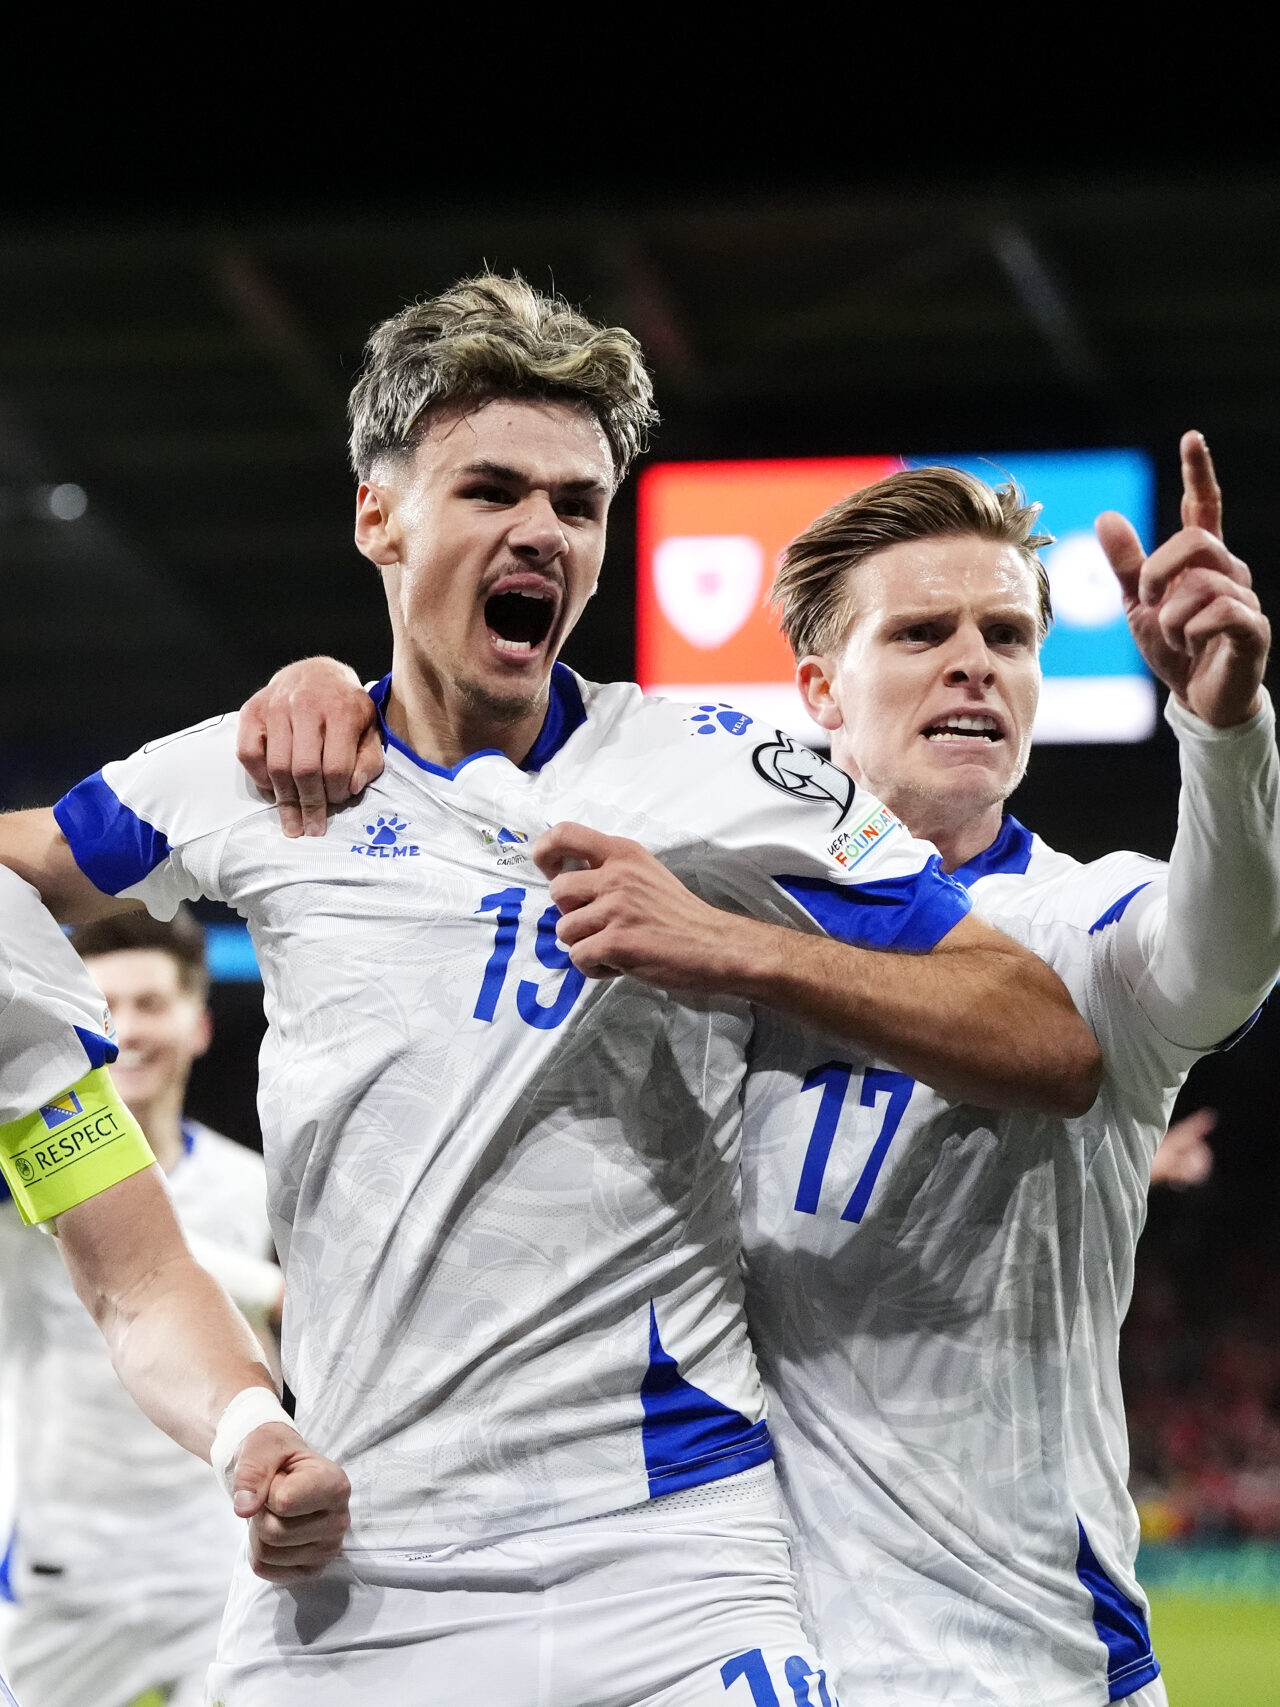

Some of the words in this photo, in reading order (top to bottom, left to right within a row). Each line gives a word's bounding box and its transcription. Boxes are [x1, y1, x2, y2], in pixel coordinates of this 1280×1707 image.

[350, 845, 421, 858] KELME
[827, 832, 850, 855] UEFA
[835, 809, 895, 867] FOUNDAT
[473, 888, 586, 1029] 19
[34, 1113, 118, 1170] RESPECT
[794, 1060, 915, 1224] 17
